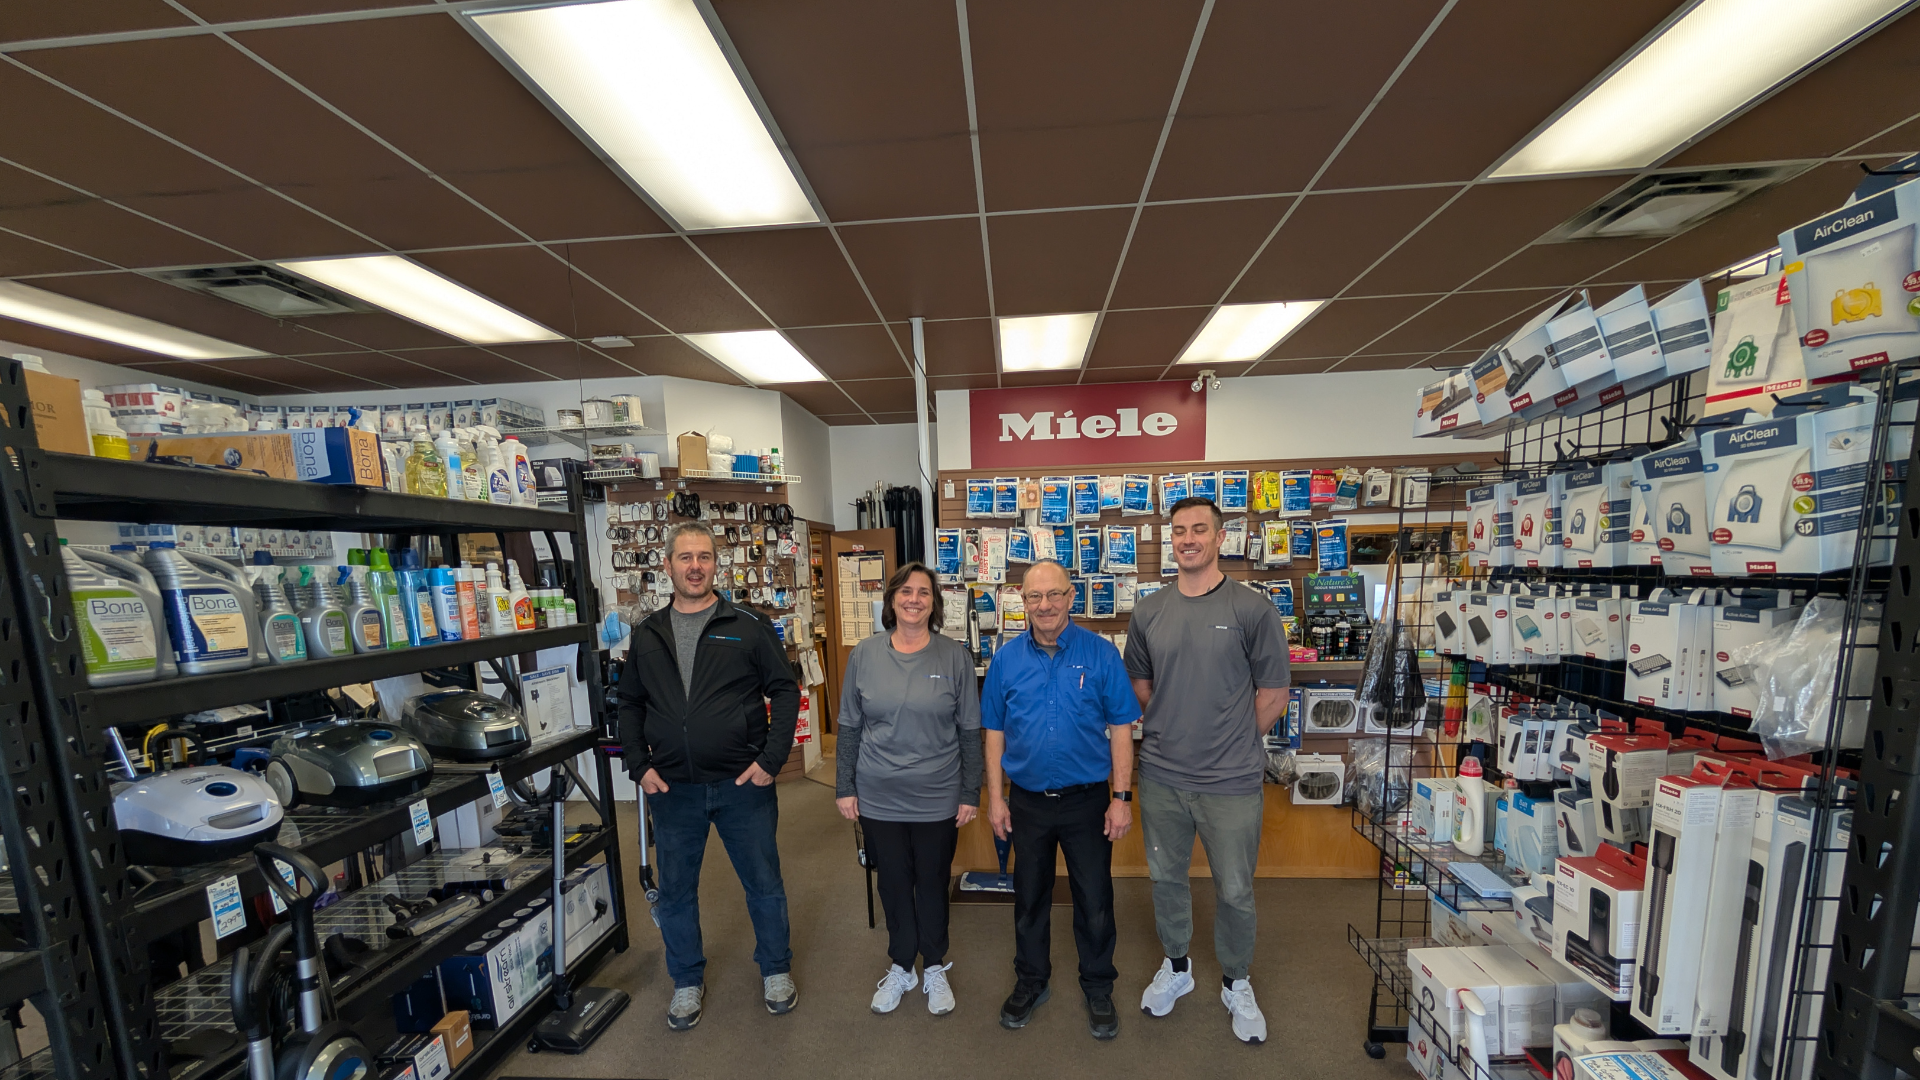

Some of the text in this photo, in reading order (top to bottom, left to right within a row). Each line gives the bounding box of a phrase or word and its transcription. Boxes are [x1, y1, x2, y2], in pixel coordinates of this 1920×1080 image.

[1813, 210, 1875, 241] AirClean
[1854, 356, 1885, 367] Miele
[1766, 380, 1800, 392] Miele
[1556, 391, 1576, 405] Miele
[1602, 388, 1622, 402] Miele
[1512, 397, 1530, 409] Miele
[998, 407, 1179, 442] Miele
[1441, 417, 1457, 427] Miele
[1728, 426, 1779, 445] AirClean
[301, 431, 318, 478] Bona
[358, 438, 374, 480] Bona
[1654, 456, 1690, 469] AirClean
[1571, 472, 1595, 482] AirClean
[1521, 480, 1541, 489] AirClean
[1474, 489, 1490, 497] AirClean
[1112, 497, 1119, 505] C
[1797, 522, 1814, 535] 3D
[994, 571, 1001, 581] J
[1316, 578, 1351, 586] Nature's
[91, 600, 146, 616] Bona
[191, 596, 238, 610] Bona
[272, 621, 294, 630] Bona
[325, 618, 344, 627] Bona
[72, 600, 98, 661] Professional
[1661, 786, 1679, 796] Miele
[1780, 803, 1808, 815] Accessories
[498, 946, 516, 1010] airstream
